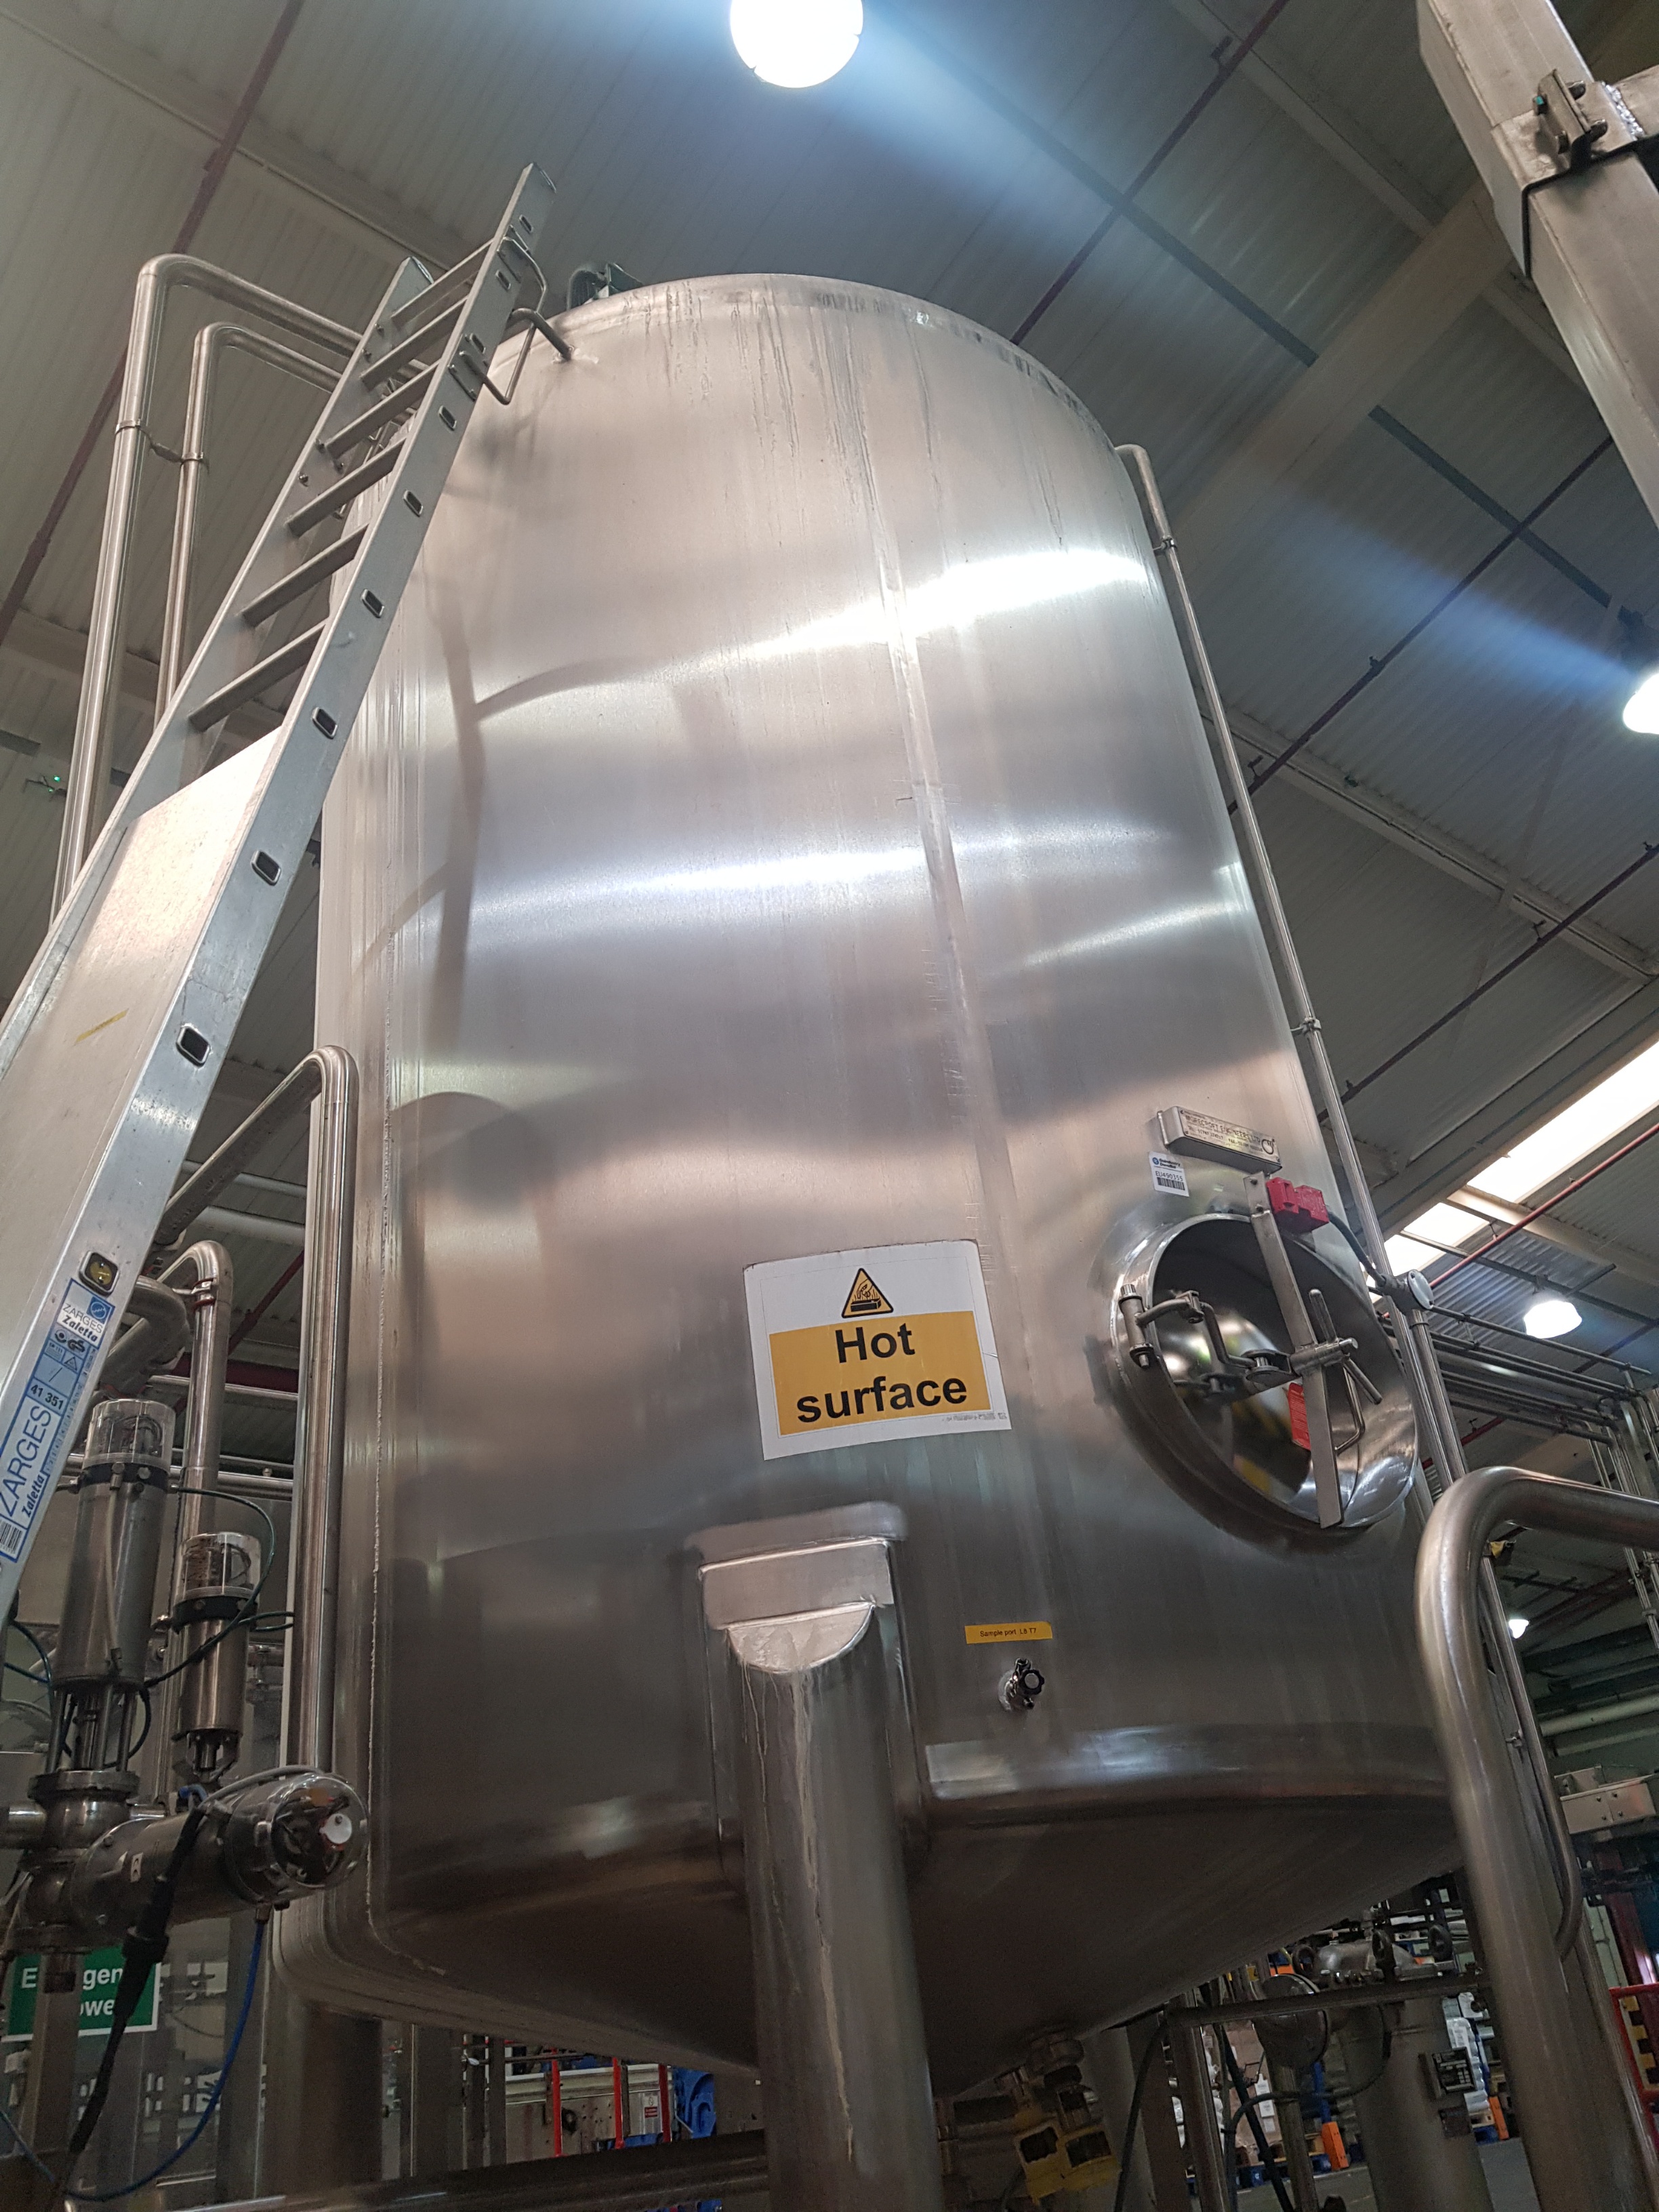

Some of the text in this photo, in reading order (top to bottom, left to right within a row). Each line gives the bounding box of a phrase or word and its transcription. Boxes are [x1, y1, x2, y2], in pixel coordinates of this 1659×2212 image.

[62, 1314, 98, 1342] Zaletta
[63, 1302, 103, 1334] ZARGES
[835, 1323, 915, 1364] Hot
[30, 1384, 43, 1397] 41
[45, 1392, 64, 1410] 351
[797, 1376, 967, 1423] surface
[22, 1474, 45, 1518] Zaletta
[1004, 1629, 1017, 1637] port
